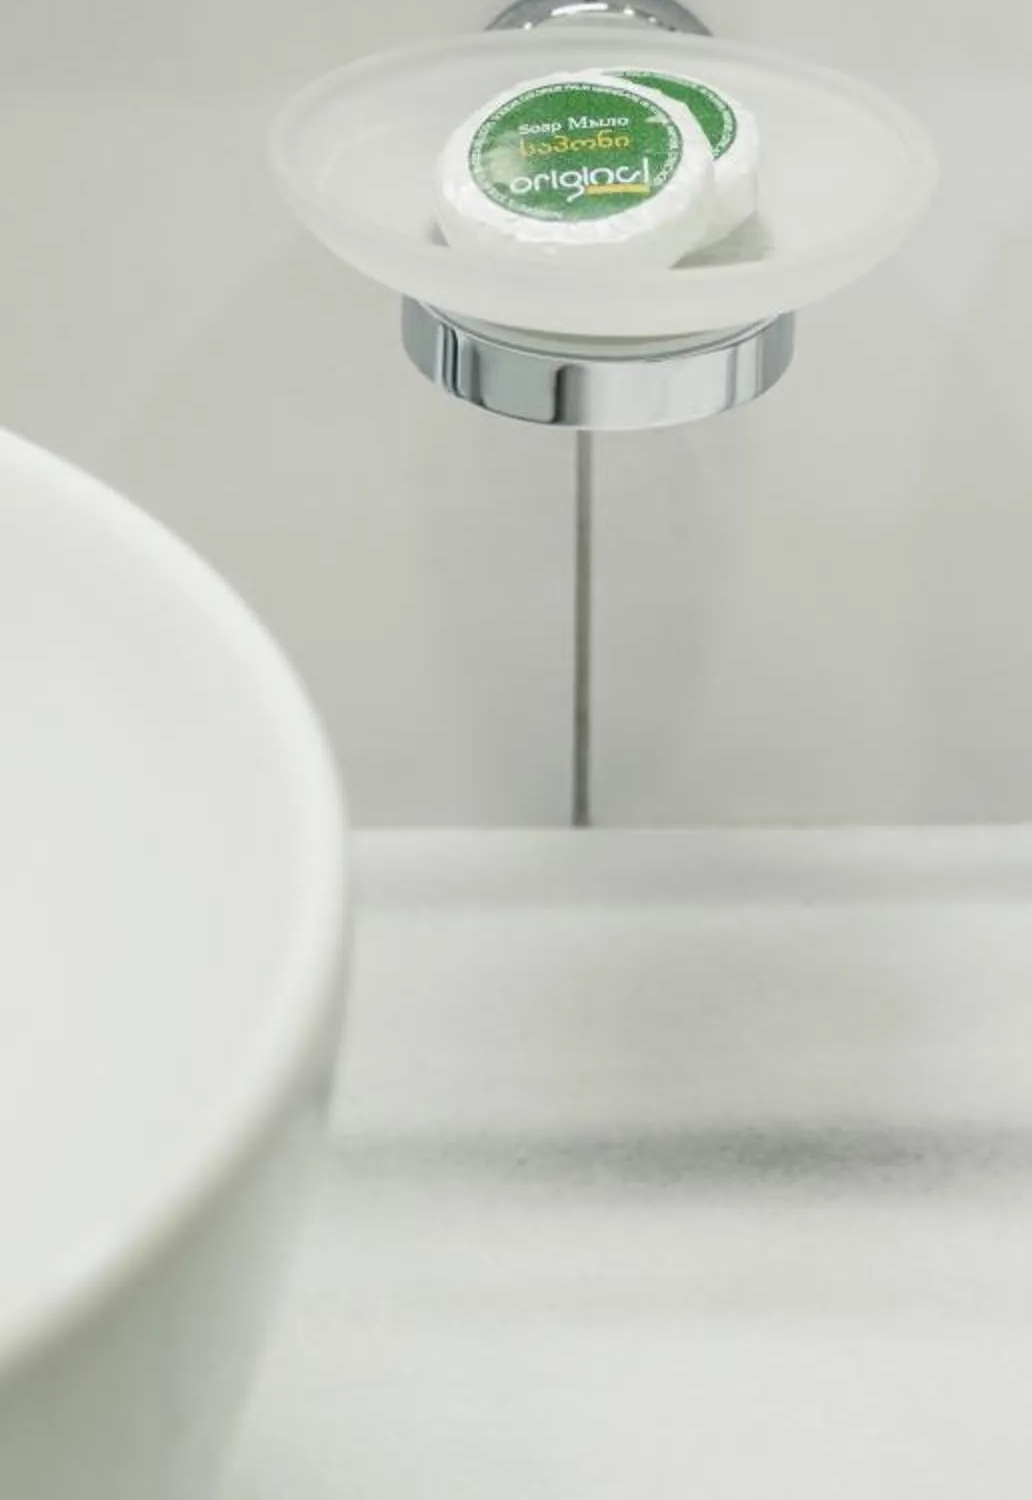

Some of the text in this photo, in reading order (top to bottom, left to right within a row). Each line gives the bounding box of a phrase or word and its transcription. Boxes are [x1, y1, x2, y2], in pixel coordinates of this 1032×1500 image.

[518, 115, 630, 135] Soap Мыло
[519, 128, 632, 158] საპონი
